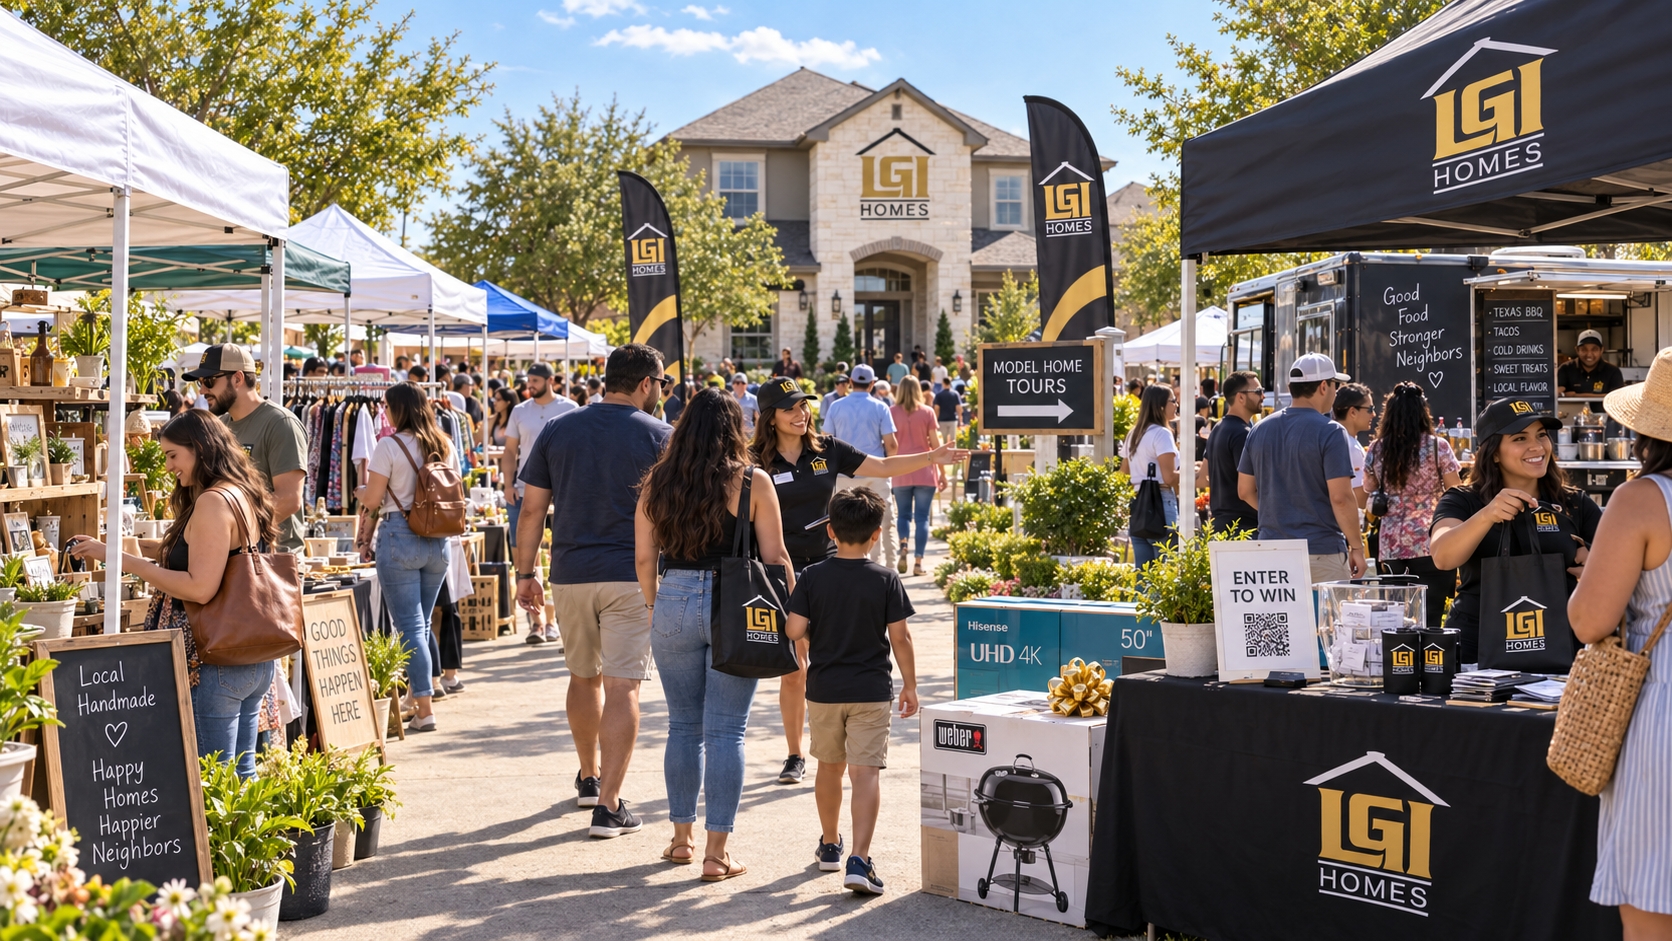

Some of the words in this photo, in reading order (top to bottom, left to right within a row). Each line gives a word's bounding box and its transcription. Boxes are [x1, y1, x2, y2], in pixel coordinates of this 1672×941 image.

[1433, 57, 1544, 160] LGI
[1434, 142, 1541, 188] HOMES
[860, 156, 930, 198] LGI
[860, 203, 929, 216] HOMES
[1043, 182, 1091, 220] LGI
[1046, 220, 1092, 234] HOMES
[631, 238, 665, 264] LGI
[632, 265, 666, 274] HOMES
[1383, 283, 1420, 305] Good
[1398, 303, 1429, 325] Food
[1493, 307, 1522, 317] TEXAS
[1525, 306, 1543, 317] BBQ
[1389, 328, 1445, 349] Stronger
[1493, 326, 1520, 337] TACOS
[1396, 346, 1463, 372] Neighbors
[1493, 345, 1514, 355] COLD
[1516, 344, 1544, 355] DRINKS
[993, 361, 1039, 374] MODEL
[1043, 359, 1082, 373] HOME
[1494, 364, 1519, 374] SWEET
[1522, 363, 1548, 373] TREATS
[1006, 378, 1067, 394] TOURS
[1493, 382, 1518, 392] LOCAL
[1520, 382, 1548, 392] FLAVOR
[1233, 570, 1289, 585] ENTER
[1230, 589, 1254, 603] TO
[1259, 588, 1296, 602] WIN
[311, 618, 346, 642] GOOD
[745, 606, 778, 632] LGI
[968, 621, 1008, 632] Hisense
[1505, 609, 1545, 639] LGI
[746, 632, 779, 642] HOMES
[1121, 629, 1153, 650] 50"
[1505, 639, 1545, 650] HOMES
[312, 643, 357, 670] THINGS
[970, 643, 1015, 664] UHD
[1018, 645, 1042, 665] 4K
[1392, 651, 1414, 666] LGI
[1424, 650, 1444, 665] LGI
[79, 661, 124, 687] Local
[319, 670, 363, 698] HAPPEN
[78, 685, 156, 716] Handmade
[331, 700, 361, 725] HERE
[938, 724, 972, 747] weber
[93, 758, 144, 786] Happy
[104, 786, 159, 809] Homes
[100, 813, 161, 841] Happier
[1317, 787, 1434, 879] LGI
[93, 836, 182, 870] Neighbors
[1319, 867, 1427, 908] HOMES
